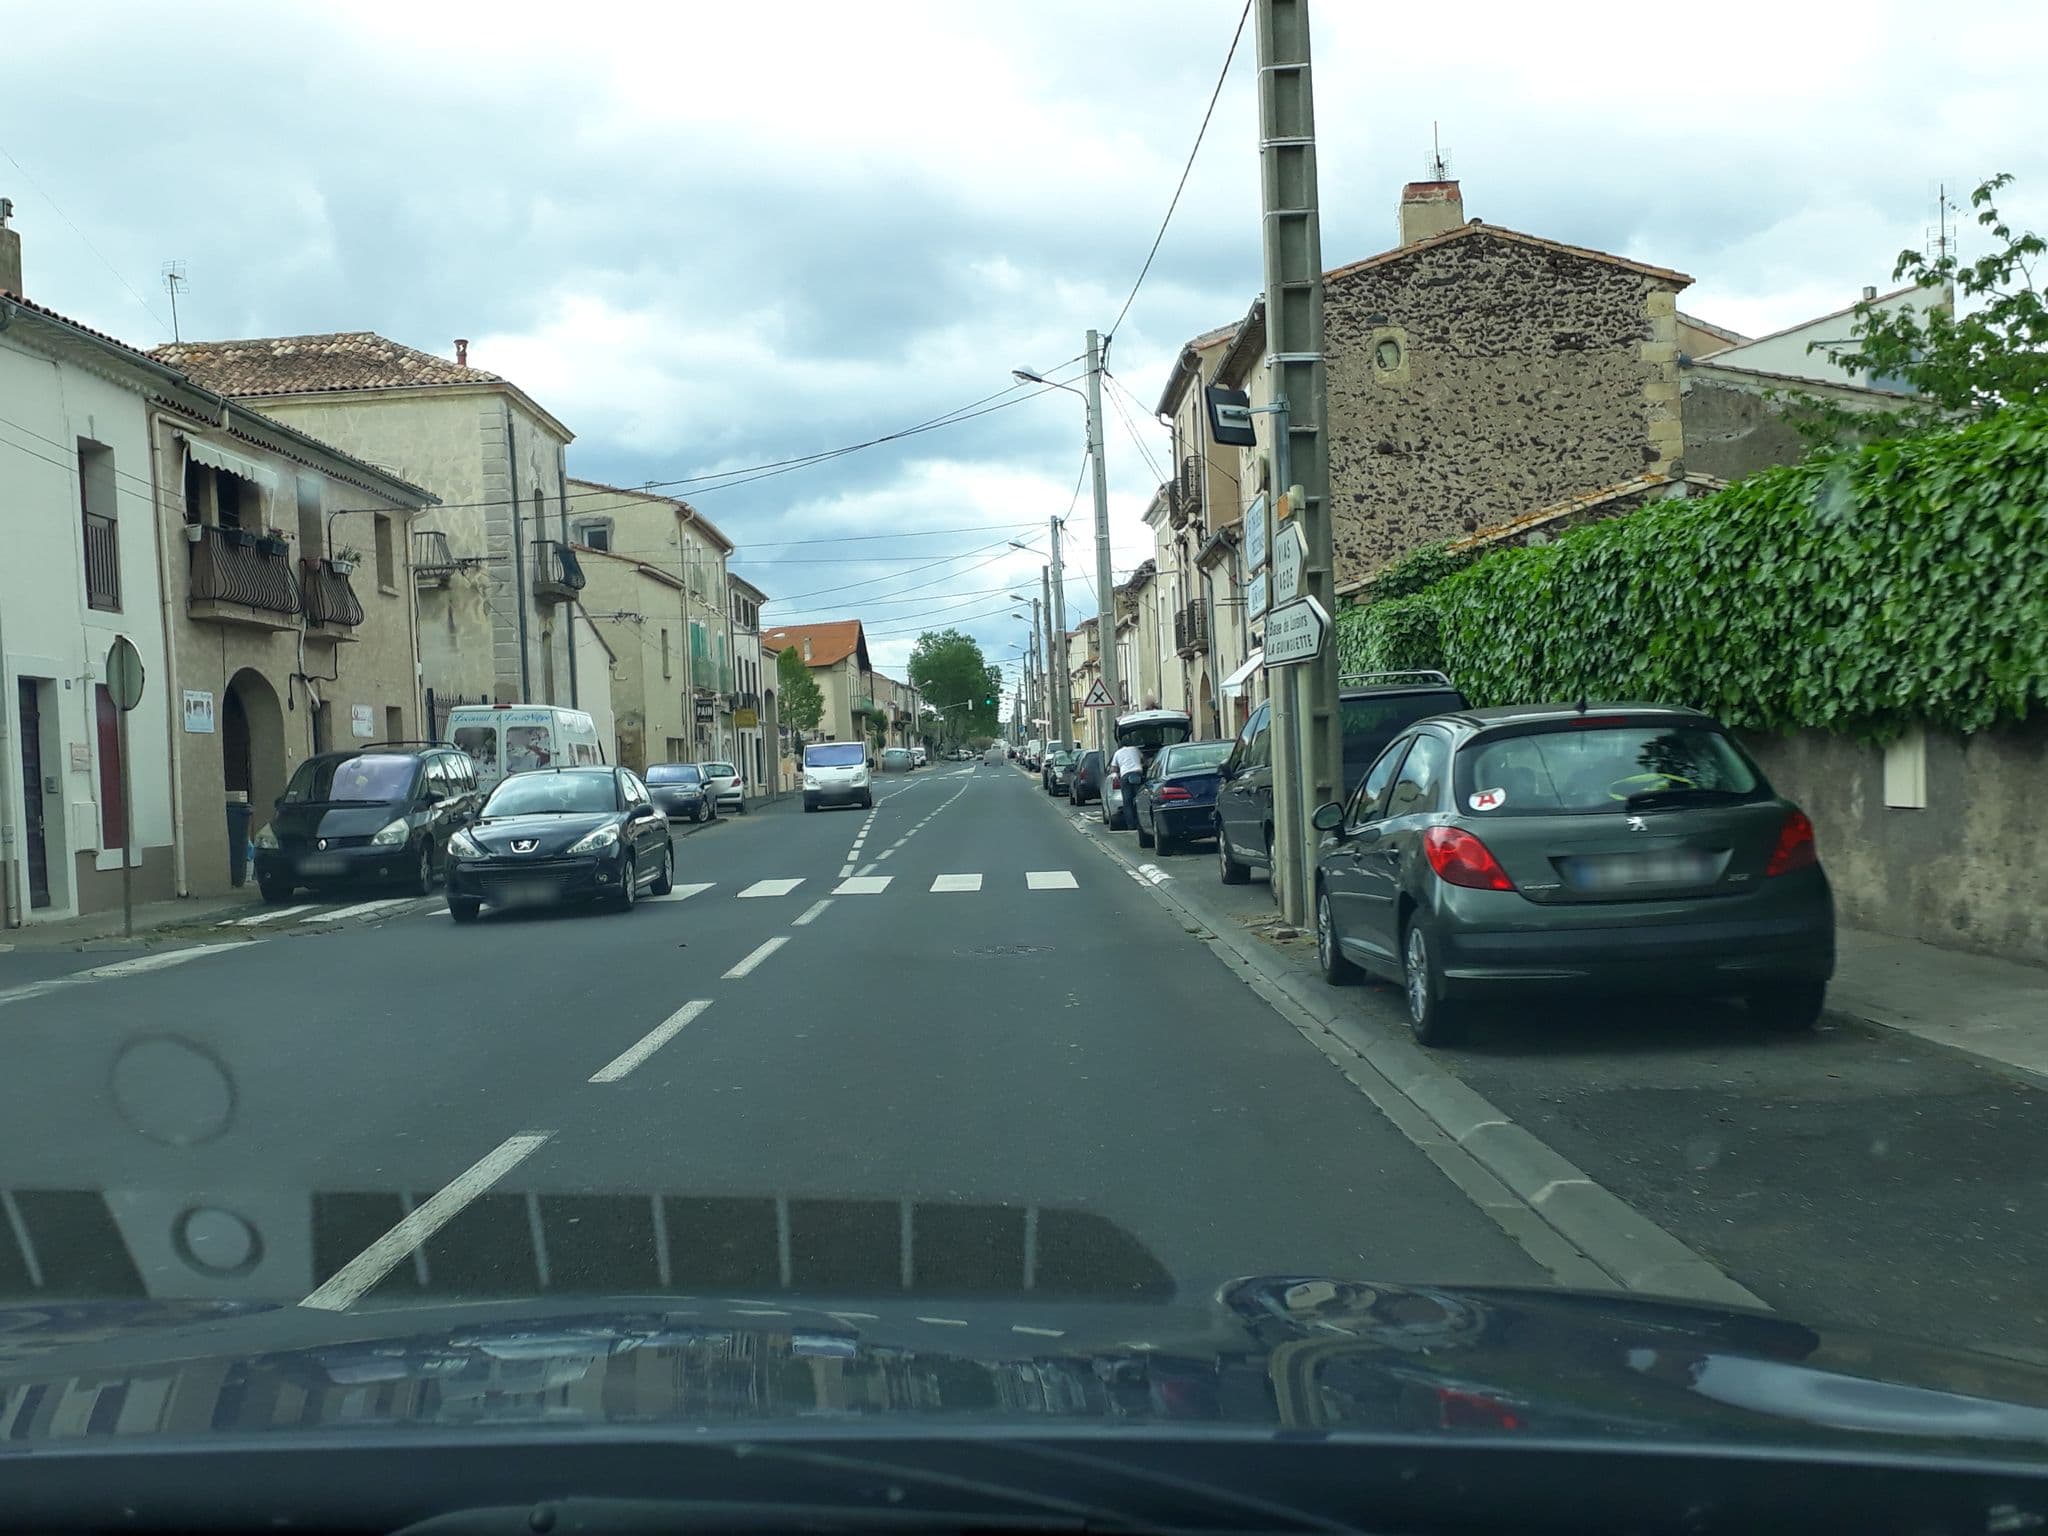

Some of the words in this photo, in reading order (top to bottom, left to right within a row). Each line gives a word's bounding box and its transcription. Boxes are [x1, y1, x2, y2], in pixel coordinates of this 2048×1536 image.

[1278, 540, 1290, 563] VIAS
[1279, 567, 1294, 590] AGDE
[1269, 621, 1282, 637] Base
[1268, 643, 1275, 656] LA
